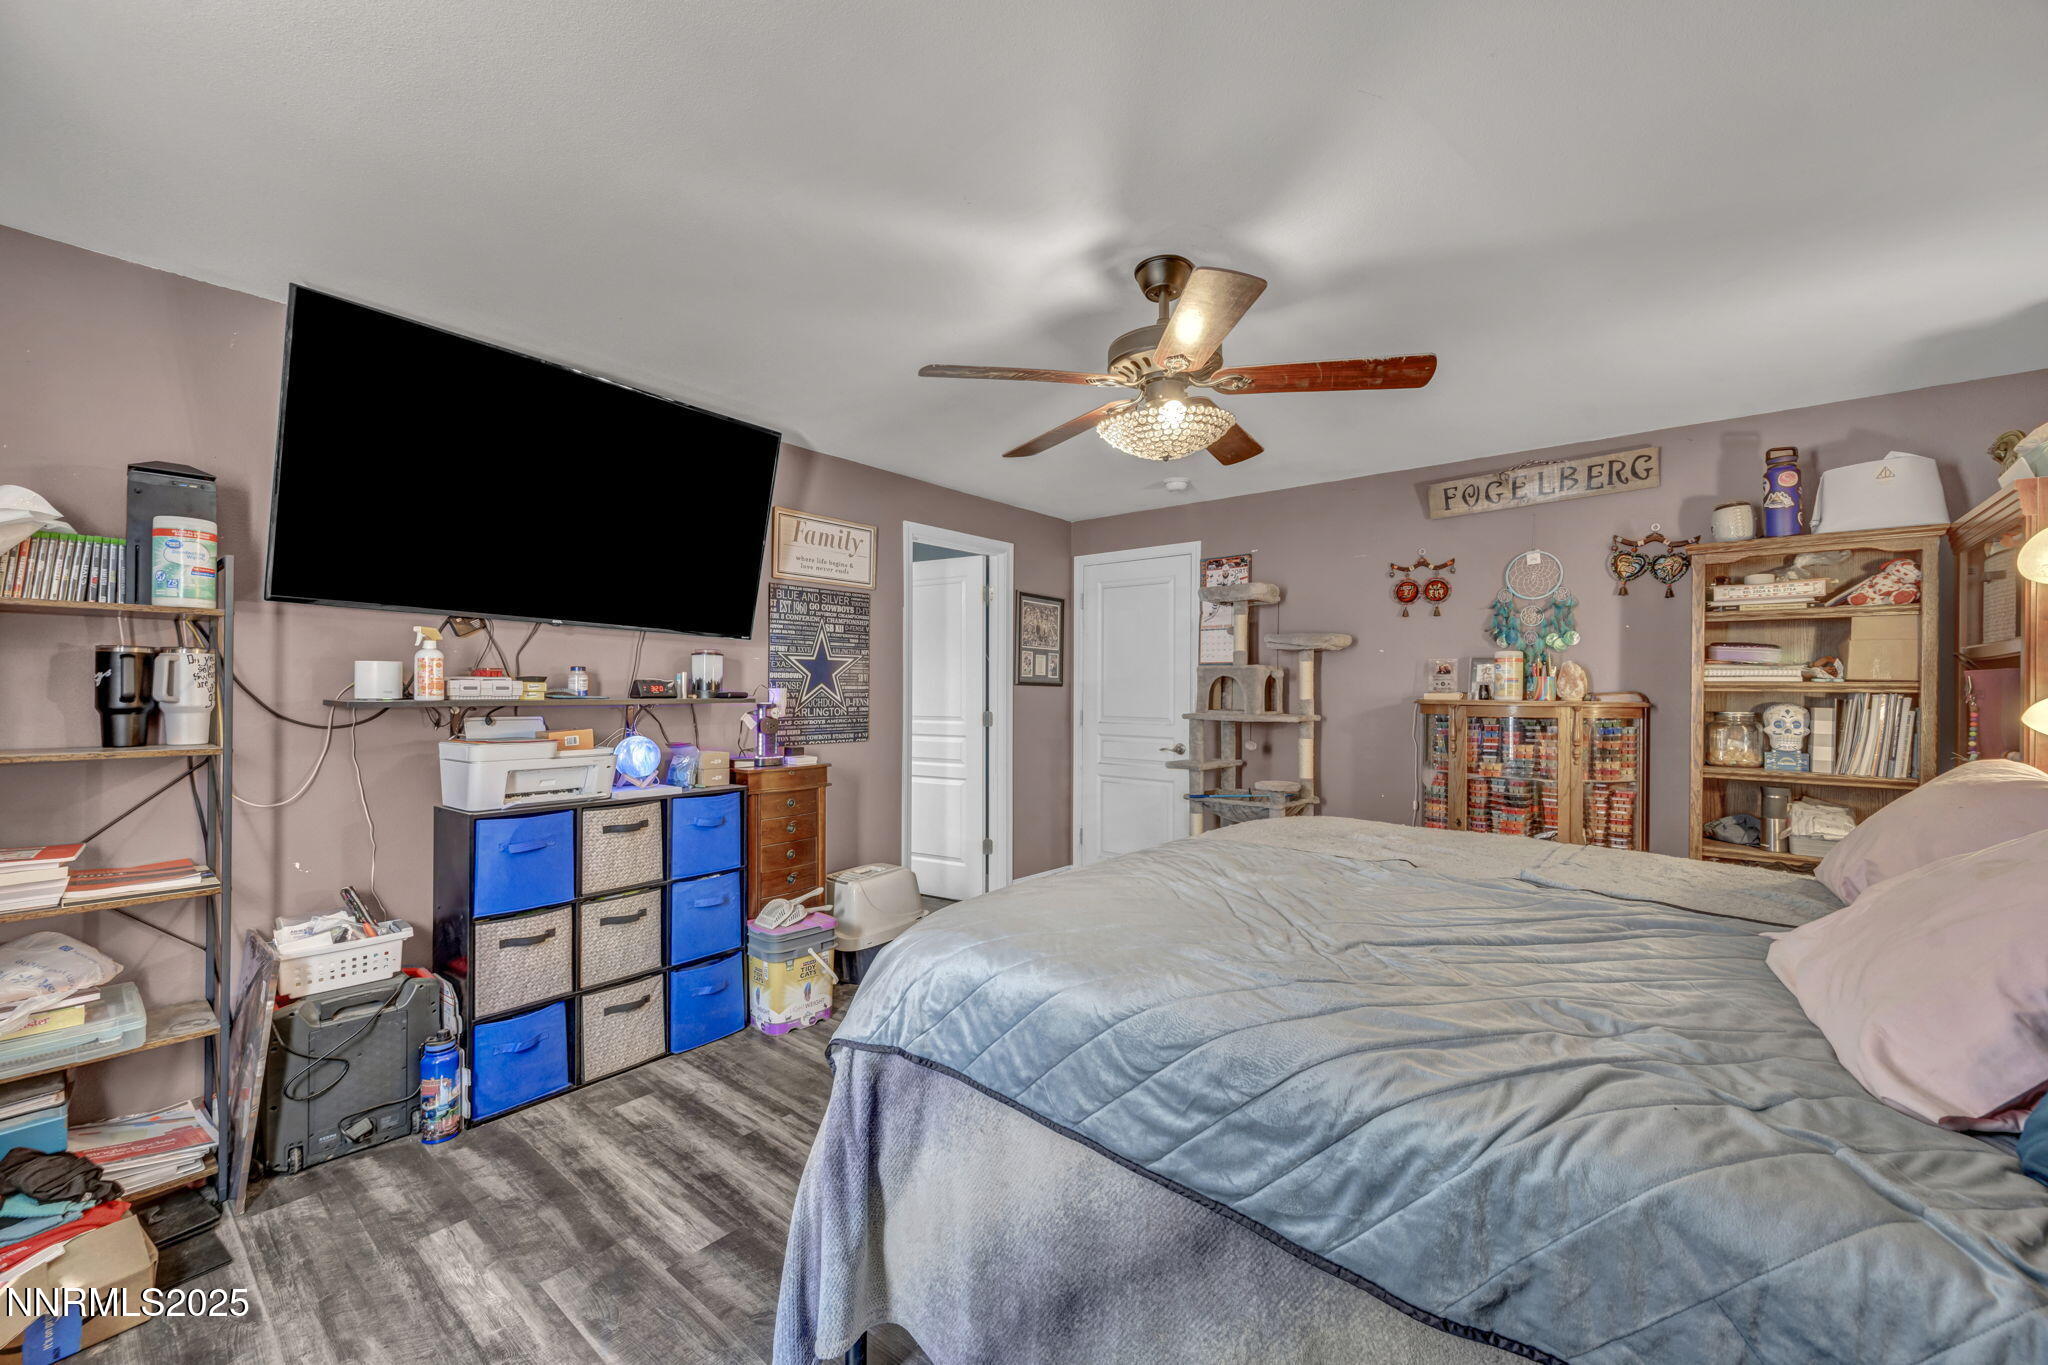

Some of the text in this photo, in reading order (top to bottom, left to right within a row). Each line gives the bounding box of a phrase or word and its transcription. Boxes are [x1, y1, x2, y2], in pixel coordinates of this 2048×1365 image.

[1442, 454, 1653, 511] FOGELBERG
[793, 519, 863, 558] Family
[795, 555, 815, 563] where
[816, 557, 828, 565] life
[776, 589, 800, 600] BLUE
[801, 591, 820, 603] AND
[821, 594, 850, 606] SILVER
[809, 602, 820, 611] GO
[821, 603, 855, 614] COWBOYS
[795, 707, 847, 717] ARLINGTON
[801, 964, 816, 973] TIDY
[800, 970, 816, 979] CATS
